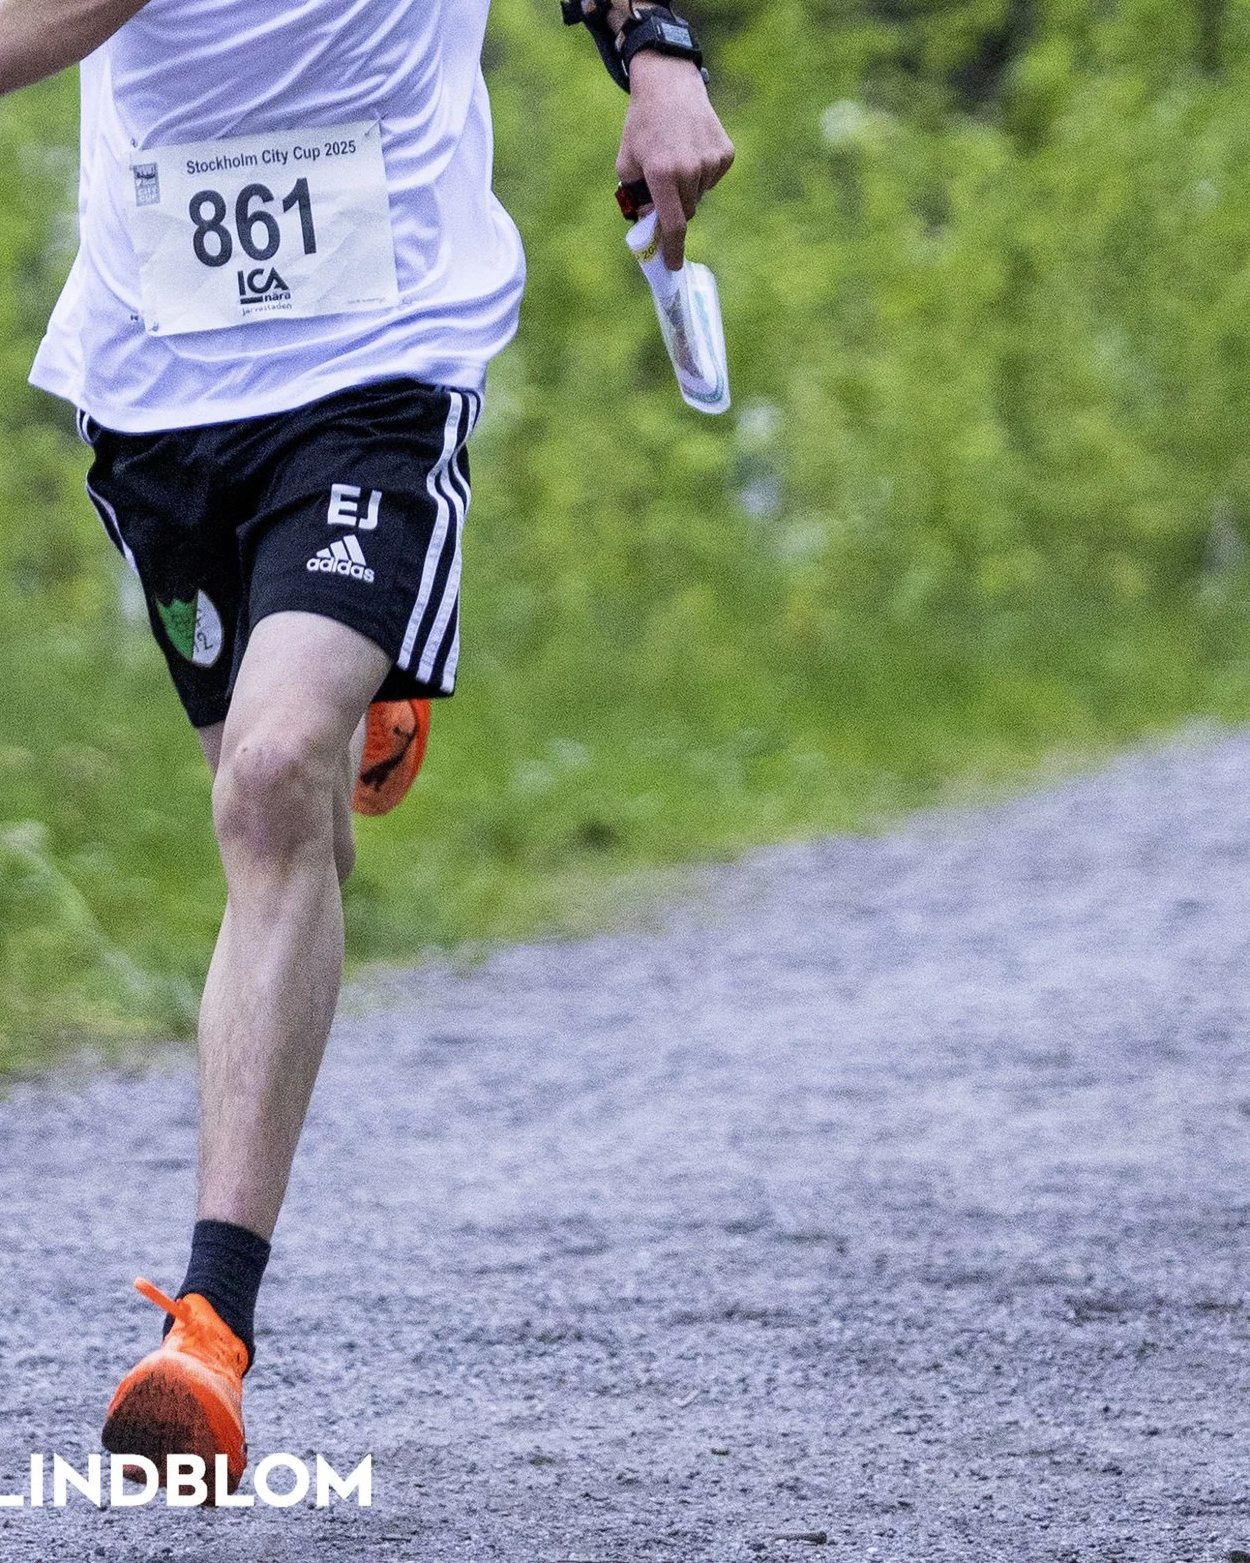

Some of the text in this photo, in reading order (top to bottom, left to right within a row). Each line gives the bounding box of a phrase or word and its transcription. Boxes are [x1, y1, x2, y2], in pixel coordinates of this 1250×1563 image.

[186, 139, 357, 175] Stockholm City Cup 2025
[188, 177, 317, 268] 861
[237, 266, 290, 296] ICA
[264, 291, 291, 302] nära
[327, 483, 383, 530] EJ
[306, 557, 375, 583] adidas
